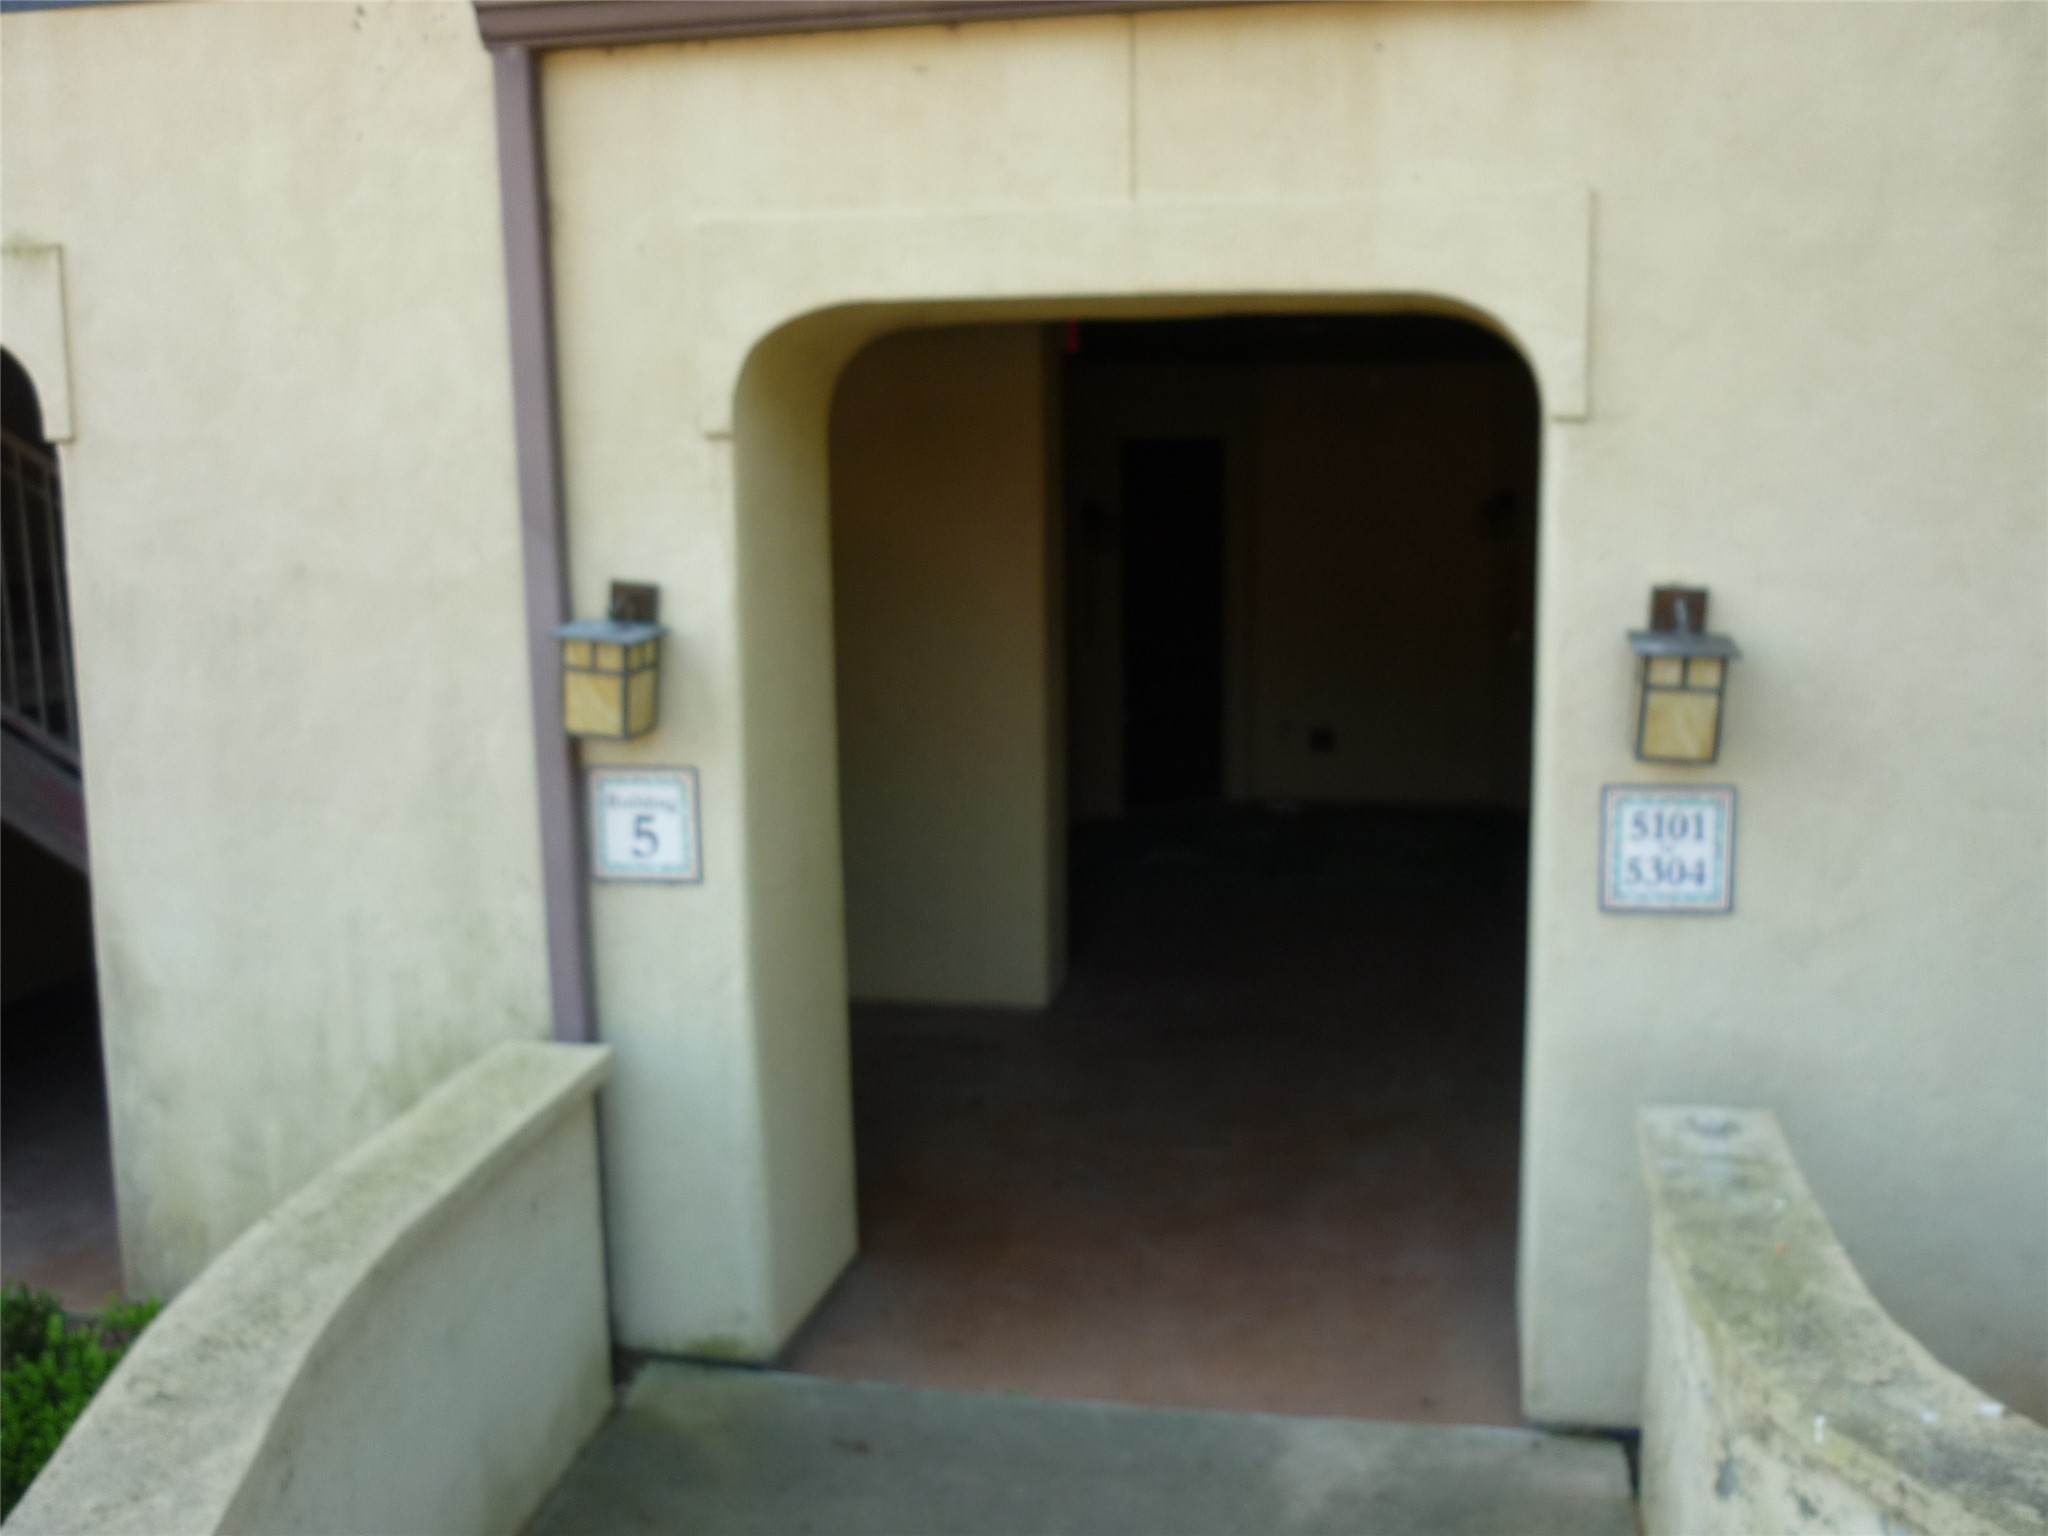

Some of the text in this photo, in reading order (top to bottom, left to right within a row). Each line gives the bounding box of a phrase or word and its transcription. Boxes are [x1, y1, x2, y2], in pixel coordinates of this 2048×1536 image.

[631, 815, 660, 858] 5
[1631, 809, 1705, 841] 5101
[1625, 857, 1707, 887] 5304
